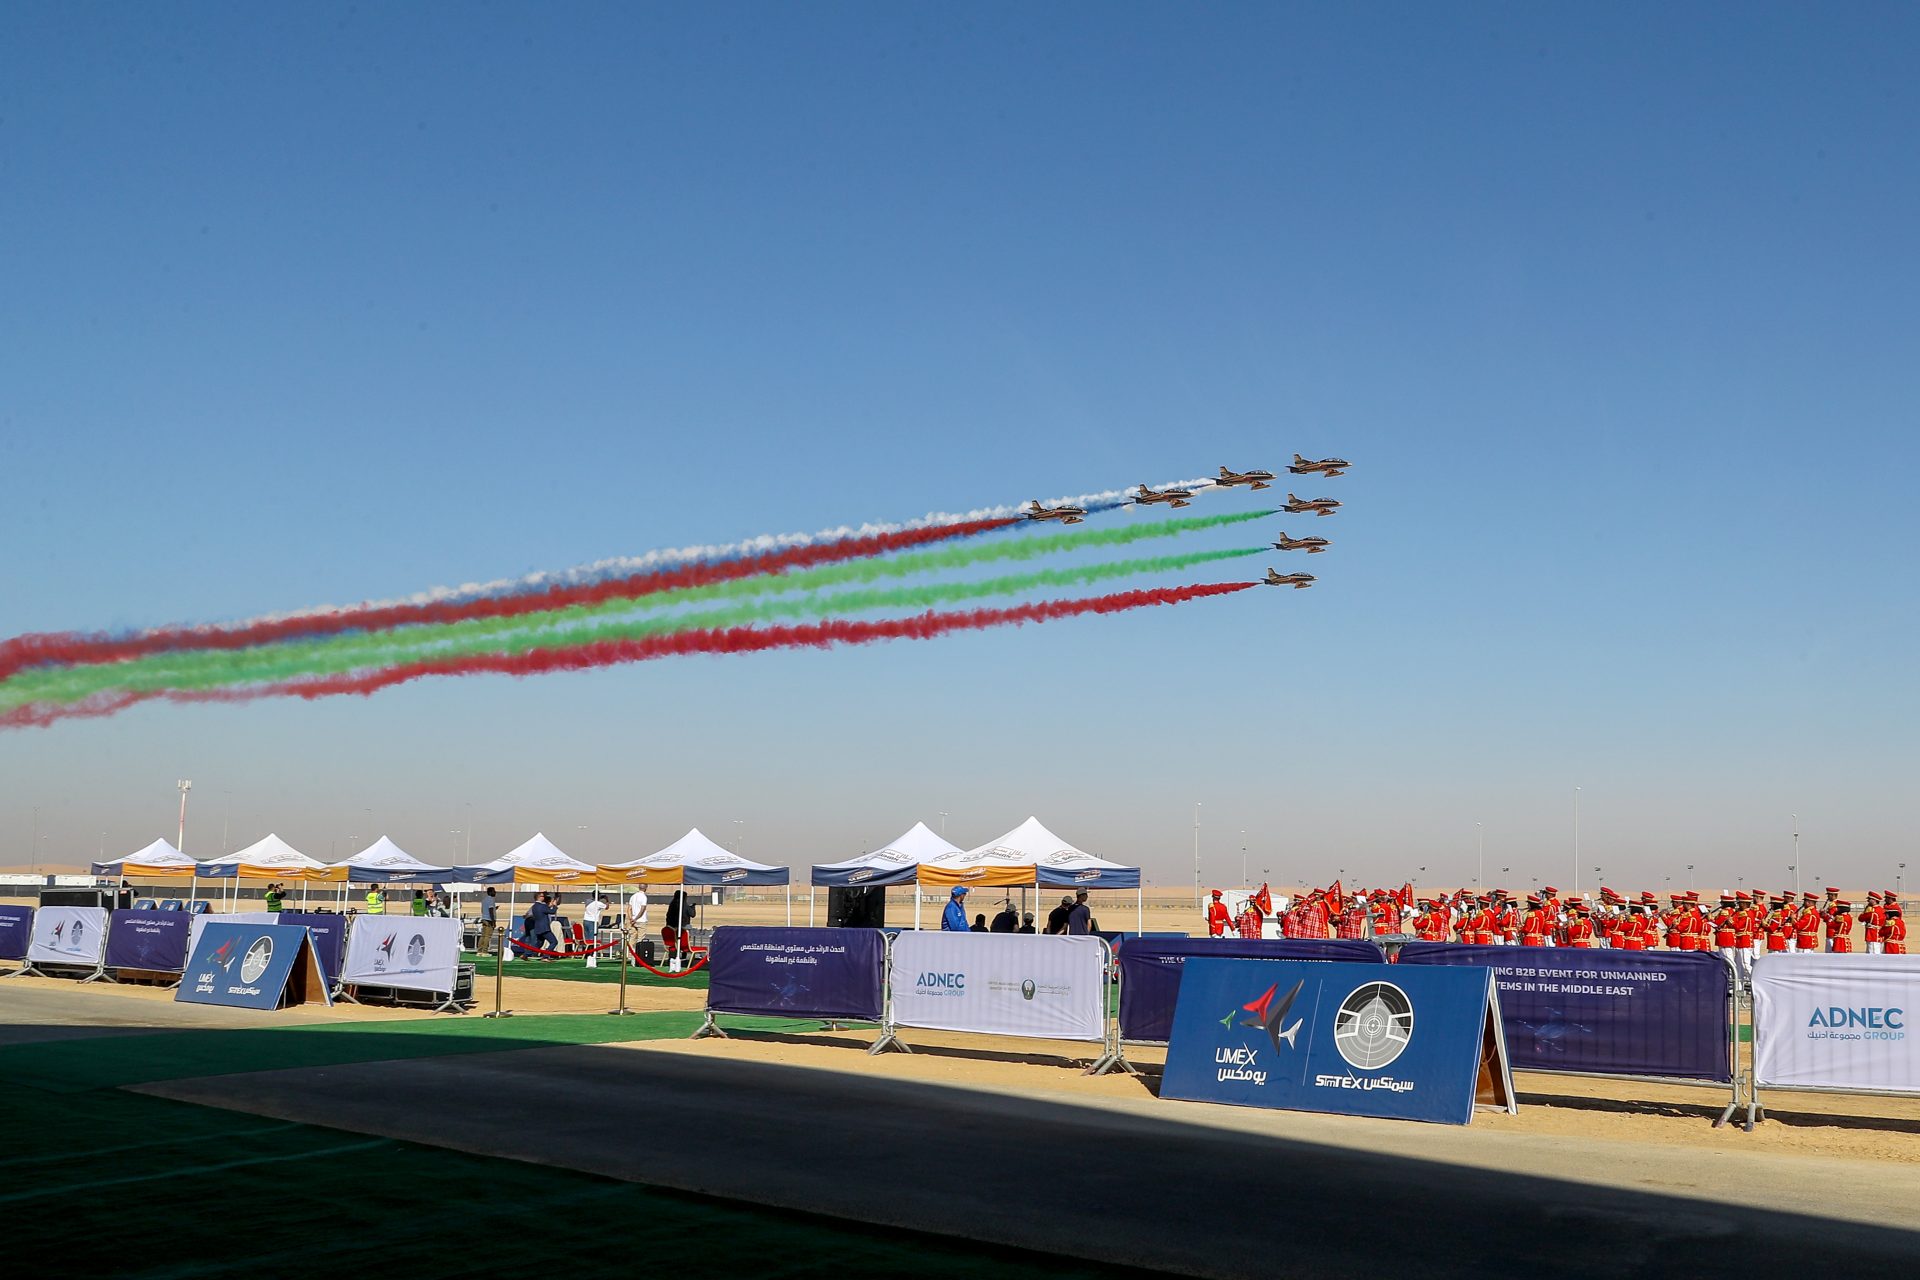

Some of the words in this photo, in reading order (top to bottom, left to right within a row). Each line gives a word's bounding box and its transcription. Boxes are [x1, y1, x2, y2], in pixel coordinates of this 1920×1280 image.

[764, 943, 785, 952] المنطقة
[785, 945, 804, 953] مستوى
[804, 945, 815, 954] على
[829, 945, 845, 953] الحدث
[916, 971, 965, 989] ADNEC
[1516, 967, 1536, 977] B2B
[1538, 968, 1572, 979] EVENT
[1575, 970, 1598, 979] FOR
[1600, 971, 1667, 982] UNMANNED
[944, 989, 965, 997] GROUP
[1524, 982, 1536, 992] IN
[1538, 983, 1559, 993] THE
[1561, 984, 1603, 995] MIDDLE
[1605, 986, 1634, 996] EAST
[1807, 1006, 1904, 1030] ADNEC
[1829, 1031, 1861, 1040] مجموعة
[1863, 1031, 1905, 1040] GROUP
[1215, 1042, 1258, 1065] UMEX
[1217, 1063, 1267, 1086] يومكس
[1363, 1076, 1415, 1093] سيمتكس
